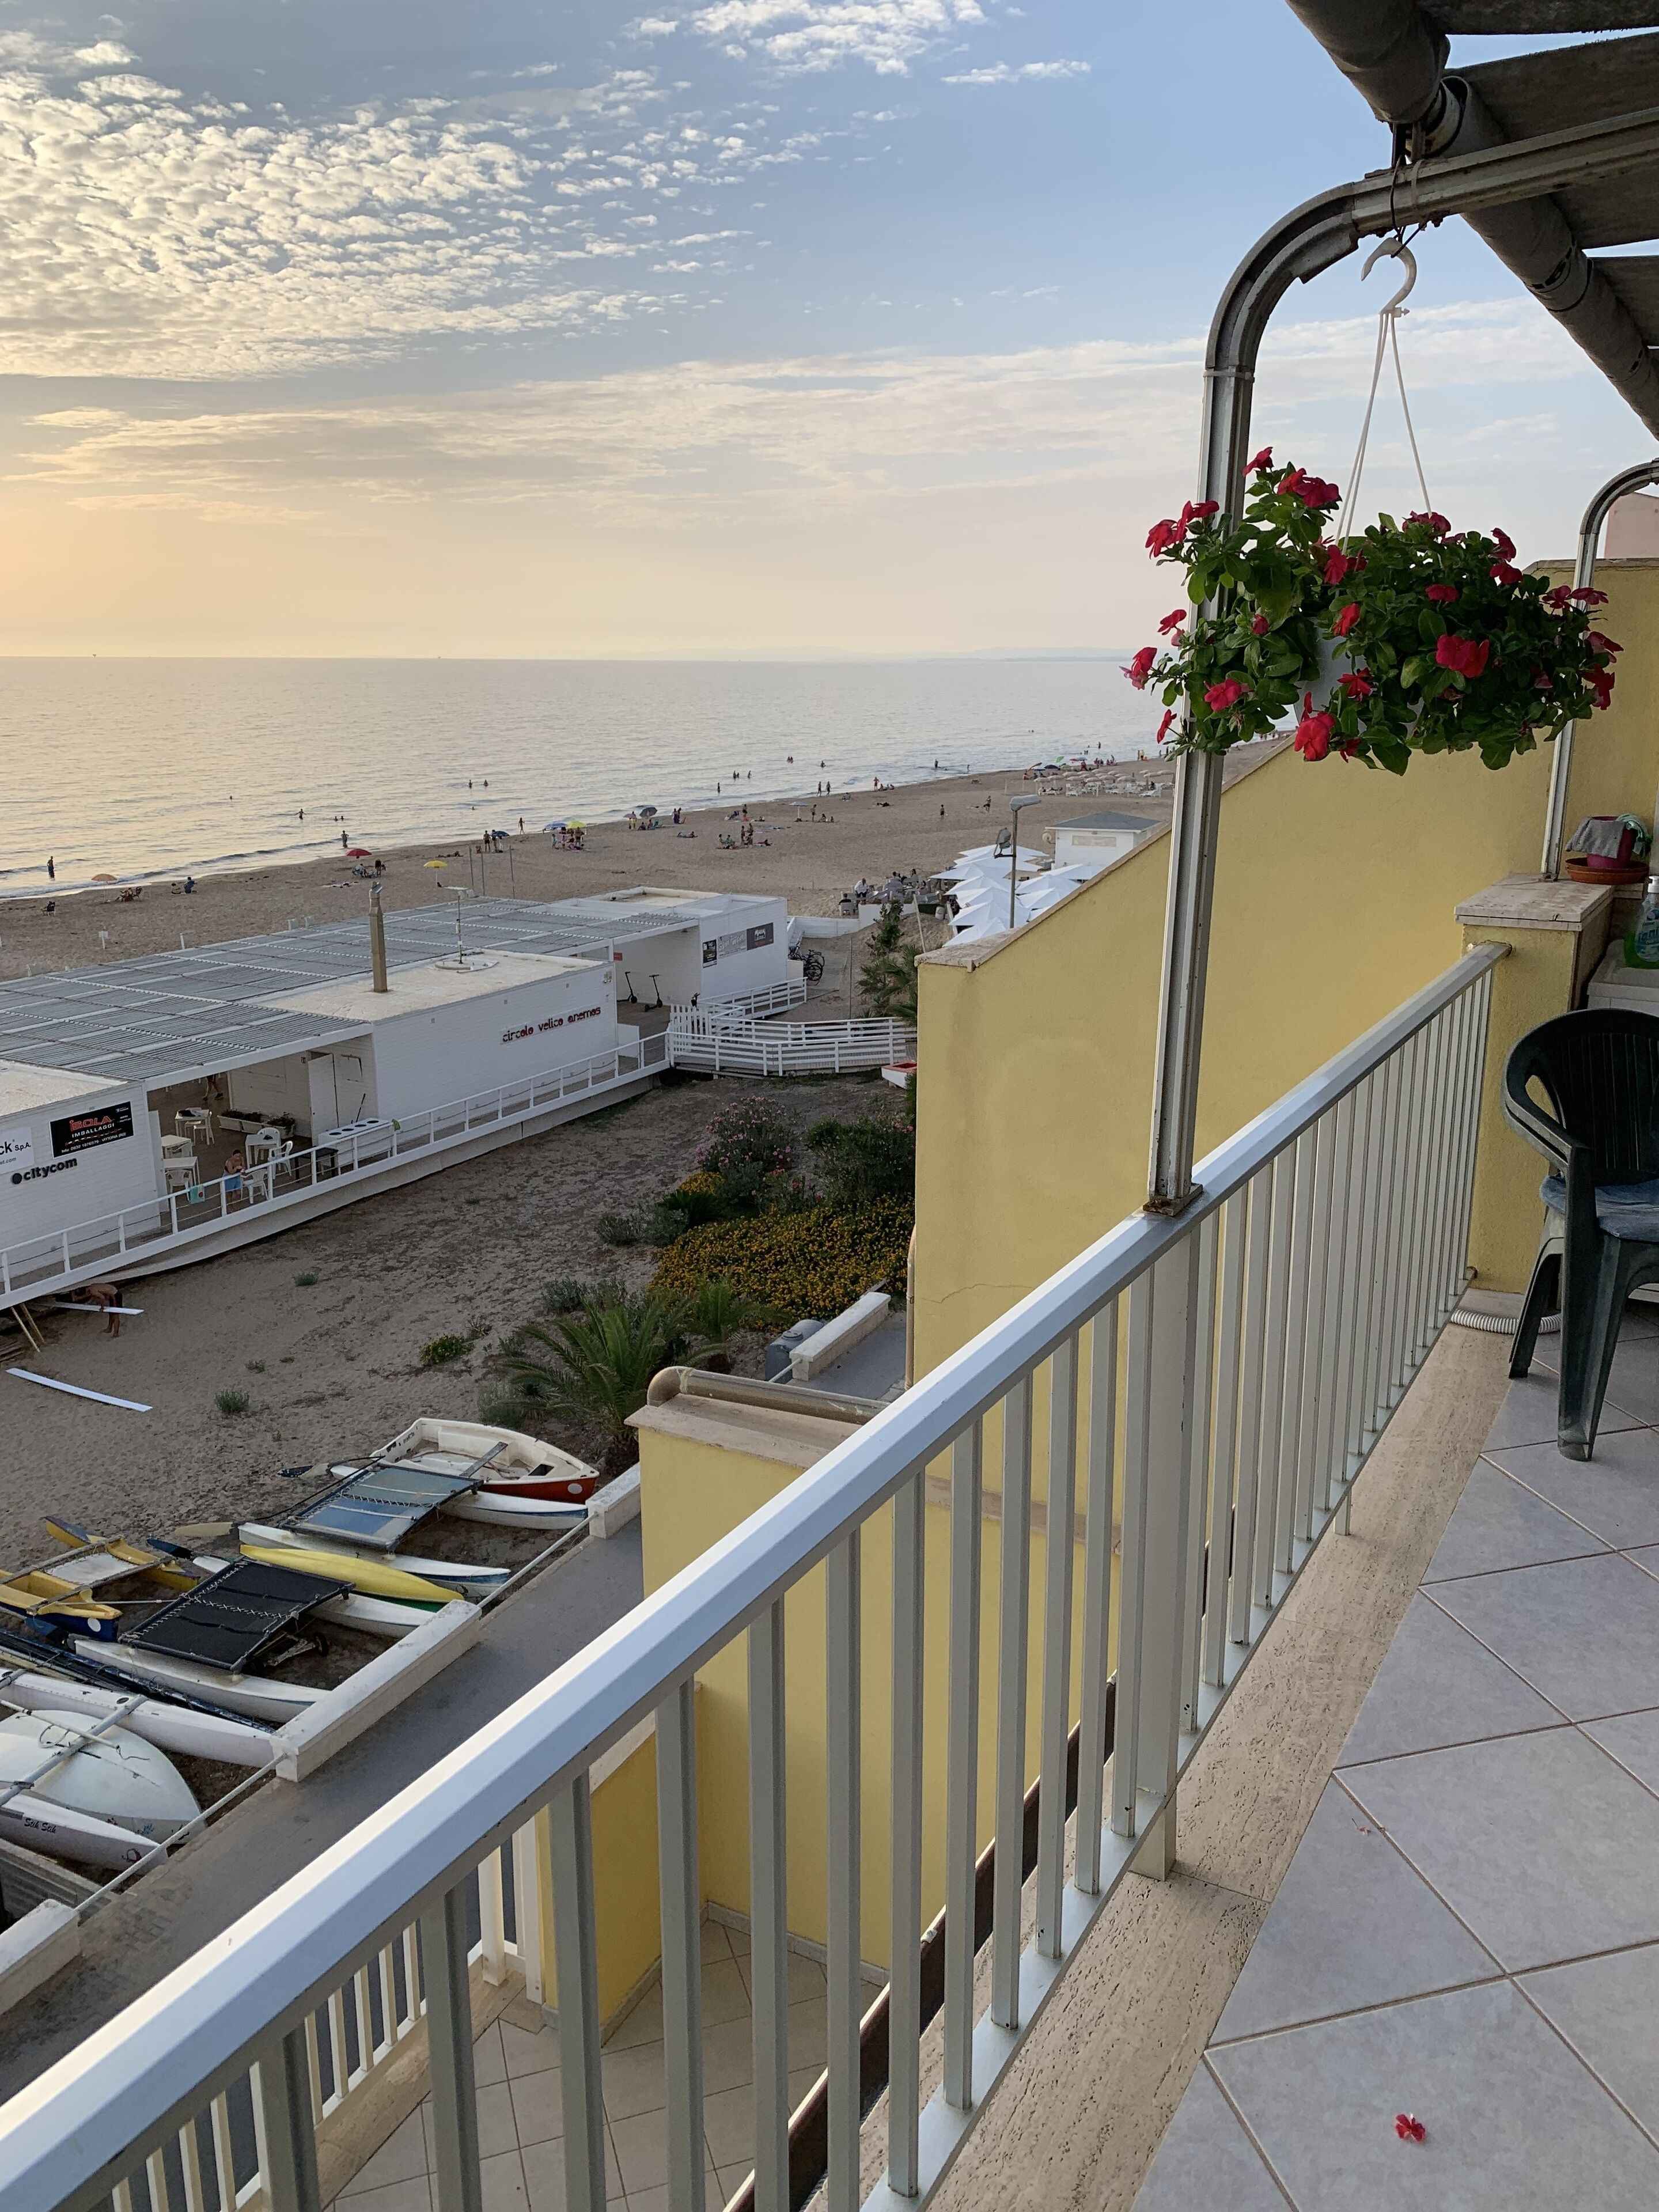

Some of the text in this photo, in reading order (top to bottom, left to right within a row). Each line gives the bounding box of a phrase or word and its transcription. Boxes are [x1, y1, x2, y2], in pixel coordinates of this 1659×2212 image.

[502, 1006, 601, 1042] circolo velico anemos
[72, 1123, 115, 1138] IMBALLAGGI
